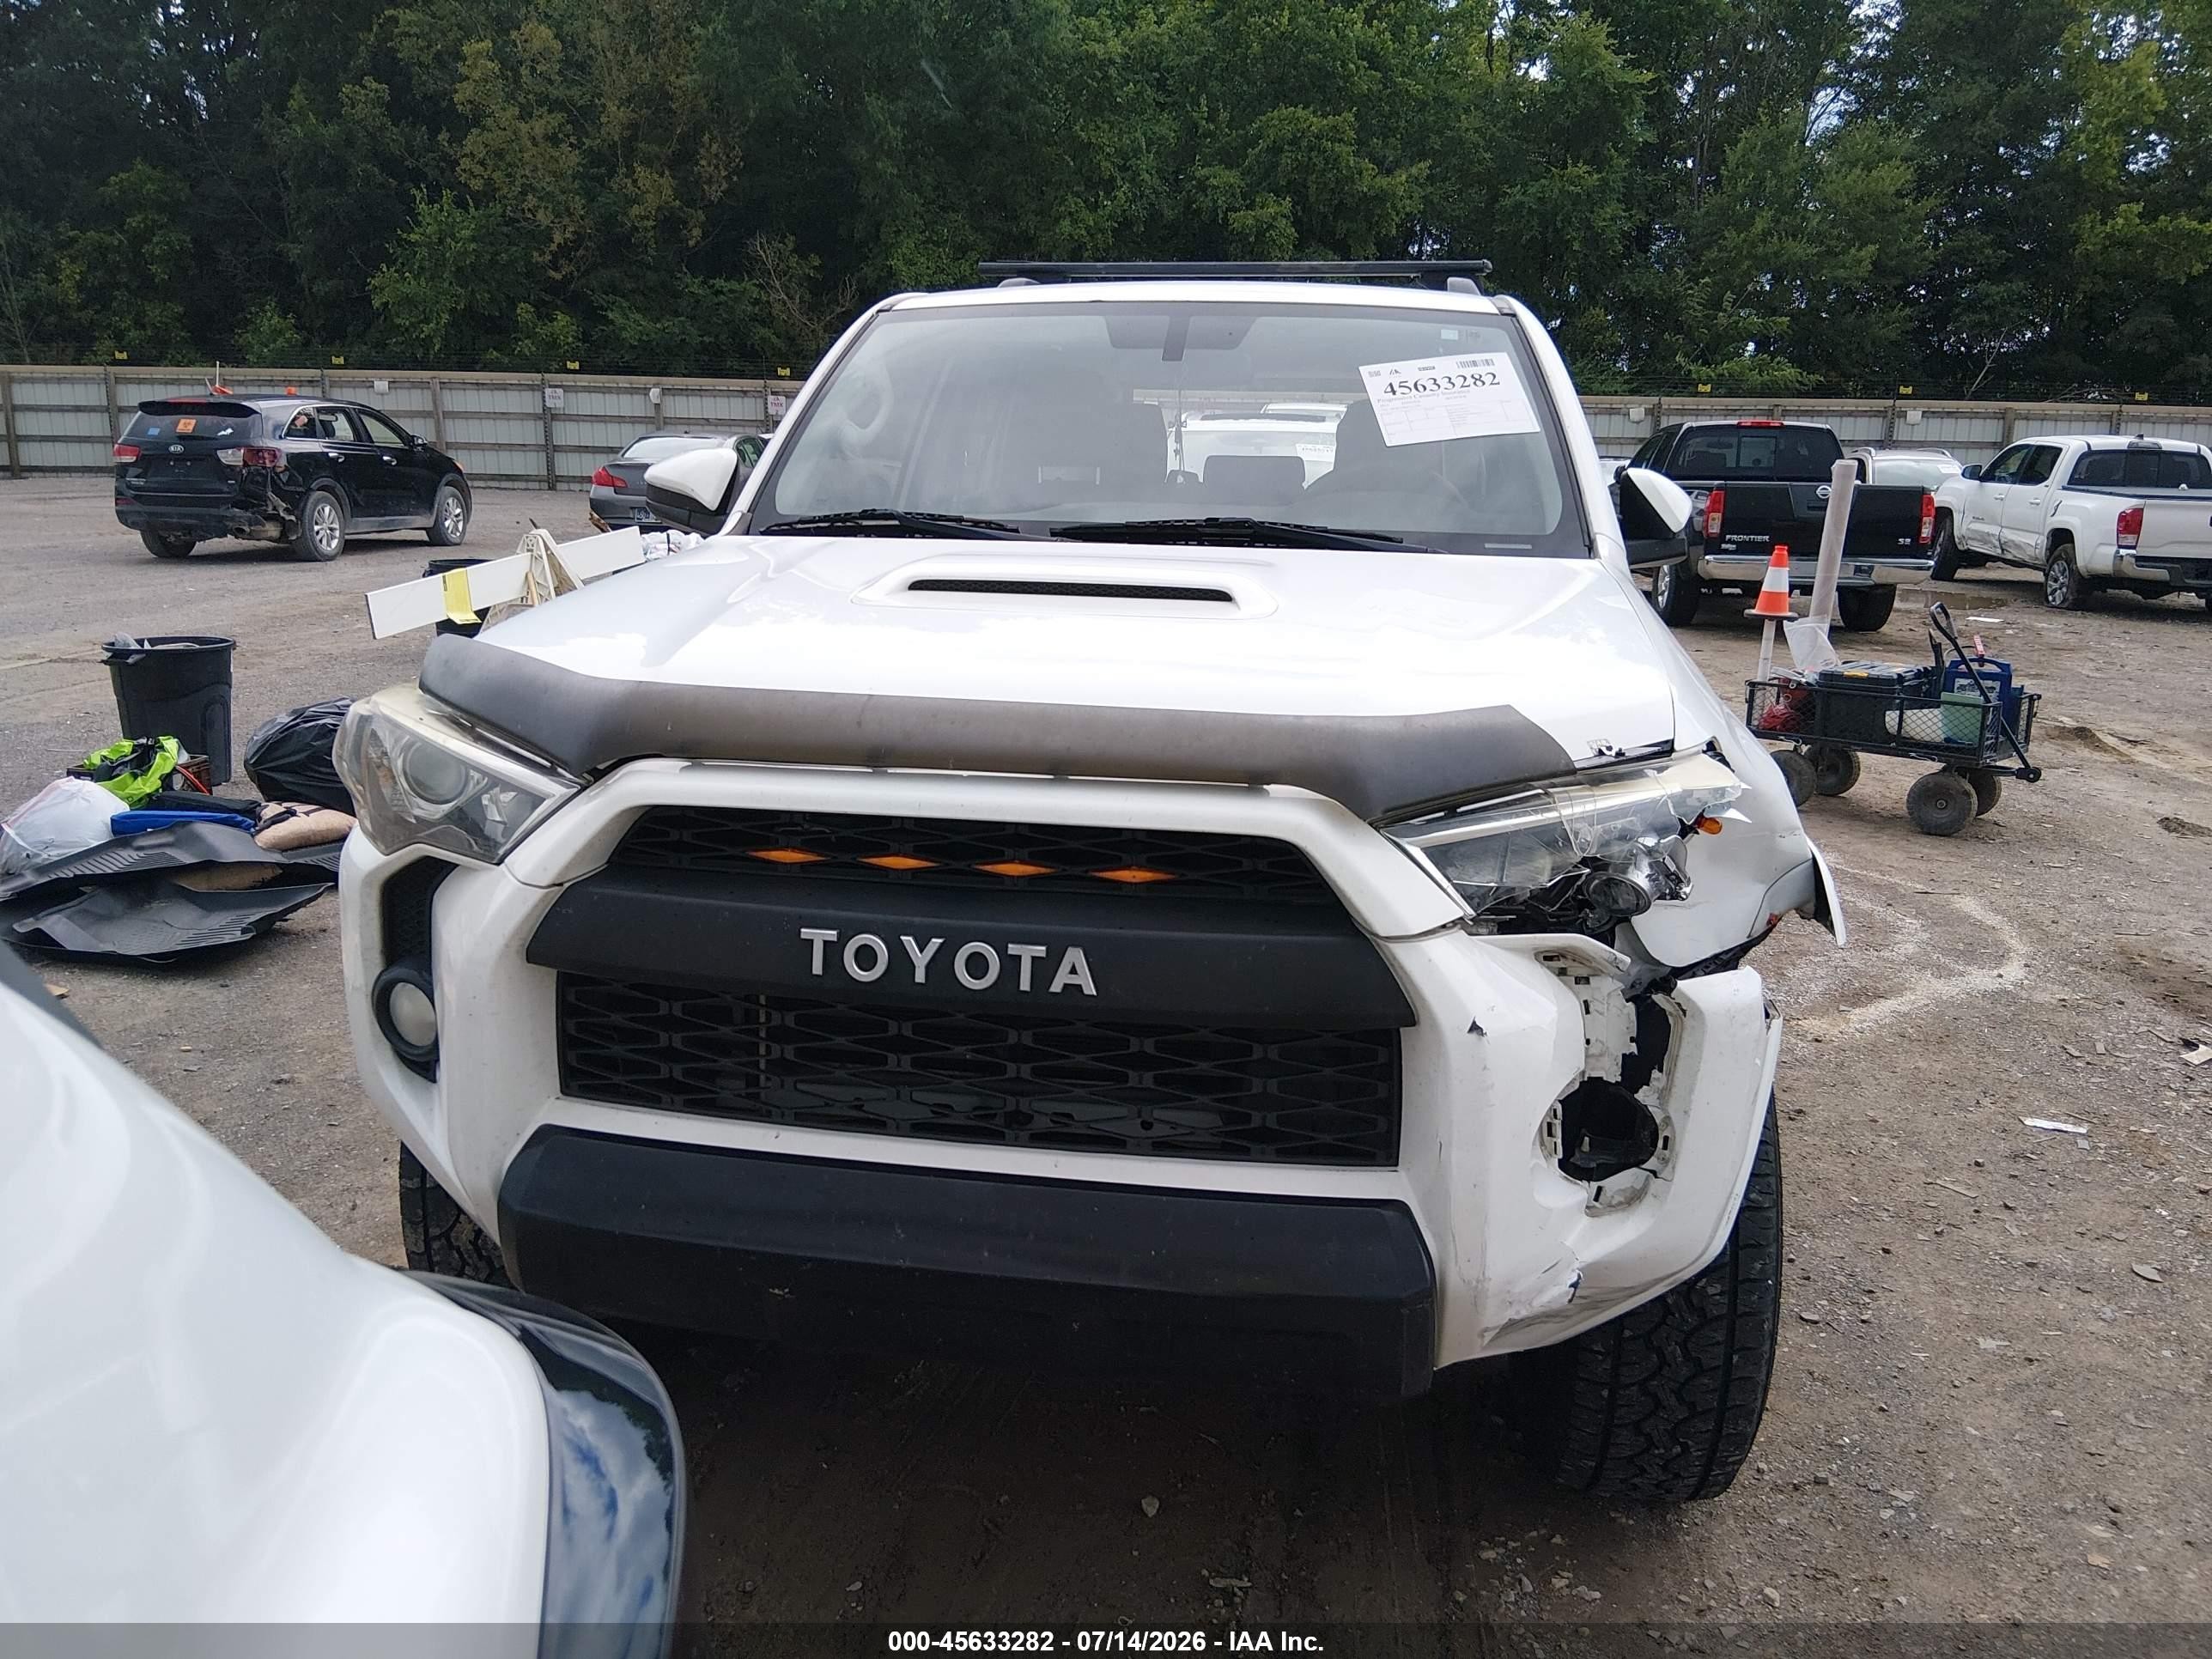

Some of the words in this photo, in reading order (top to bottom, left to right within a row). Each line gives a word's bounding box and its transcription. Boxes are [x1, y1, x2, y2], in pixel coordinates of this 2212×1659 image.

[1383, 372, 1500, 396] 45633282
[170, 445, 183, 453] KIA
[1724, 534, 1771, 543] FRONTIER
[799, 927, 1097, 997] TOYOTA
